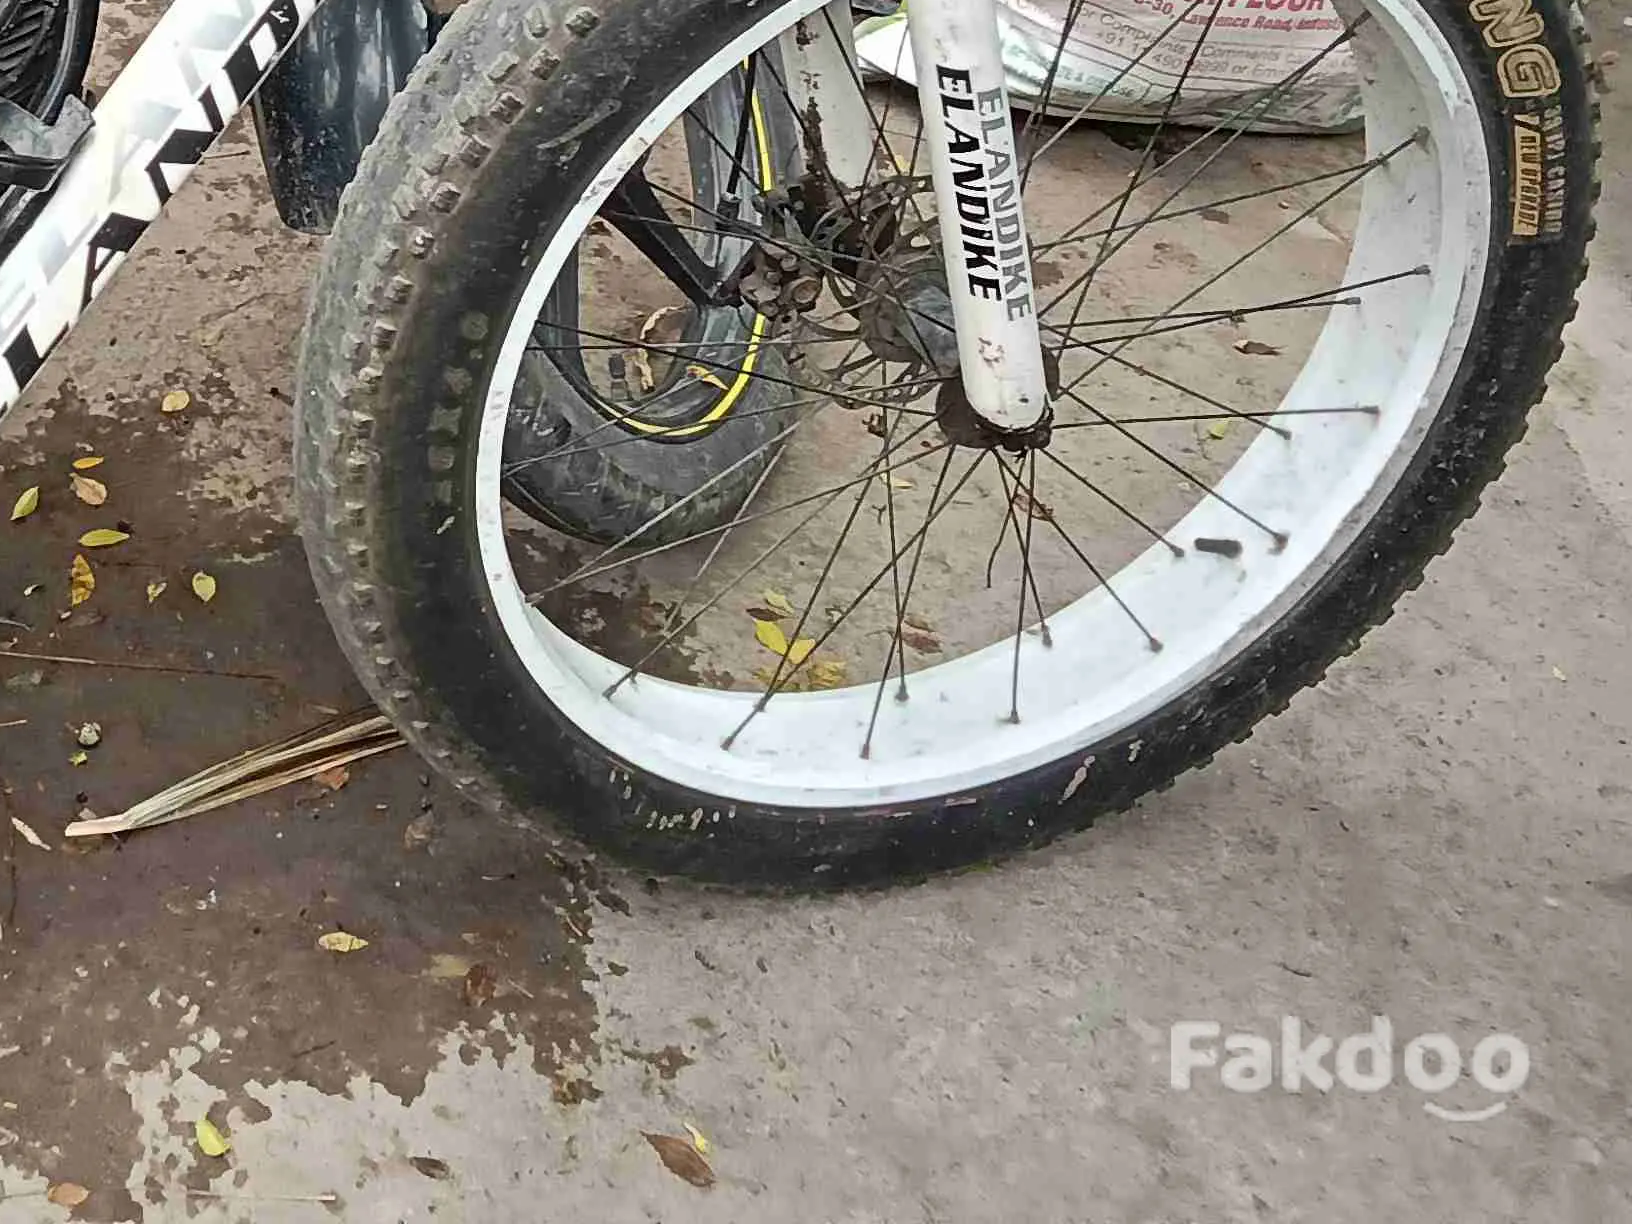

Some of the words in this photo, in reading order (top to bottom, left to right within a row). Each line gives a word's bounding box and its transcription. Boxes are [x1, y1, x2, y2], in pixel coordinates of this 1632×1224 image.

[935, 64, 1003, 304] ELANDIKE
[976, 86, 1036, 324] ELANDIKE
[1520, 134, 1539, 164] NEW
